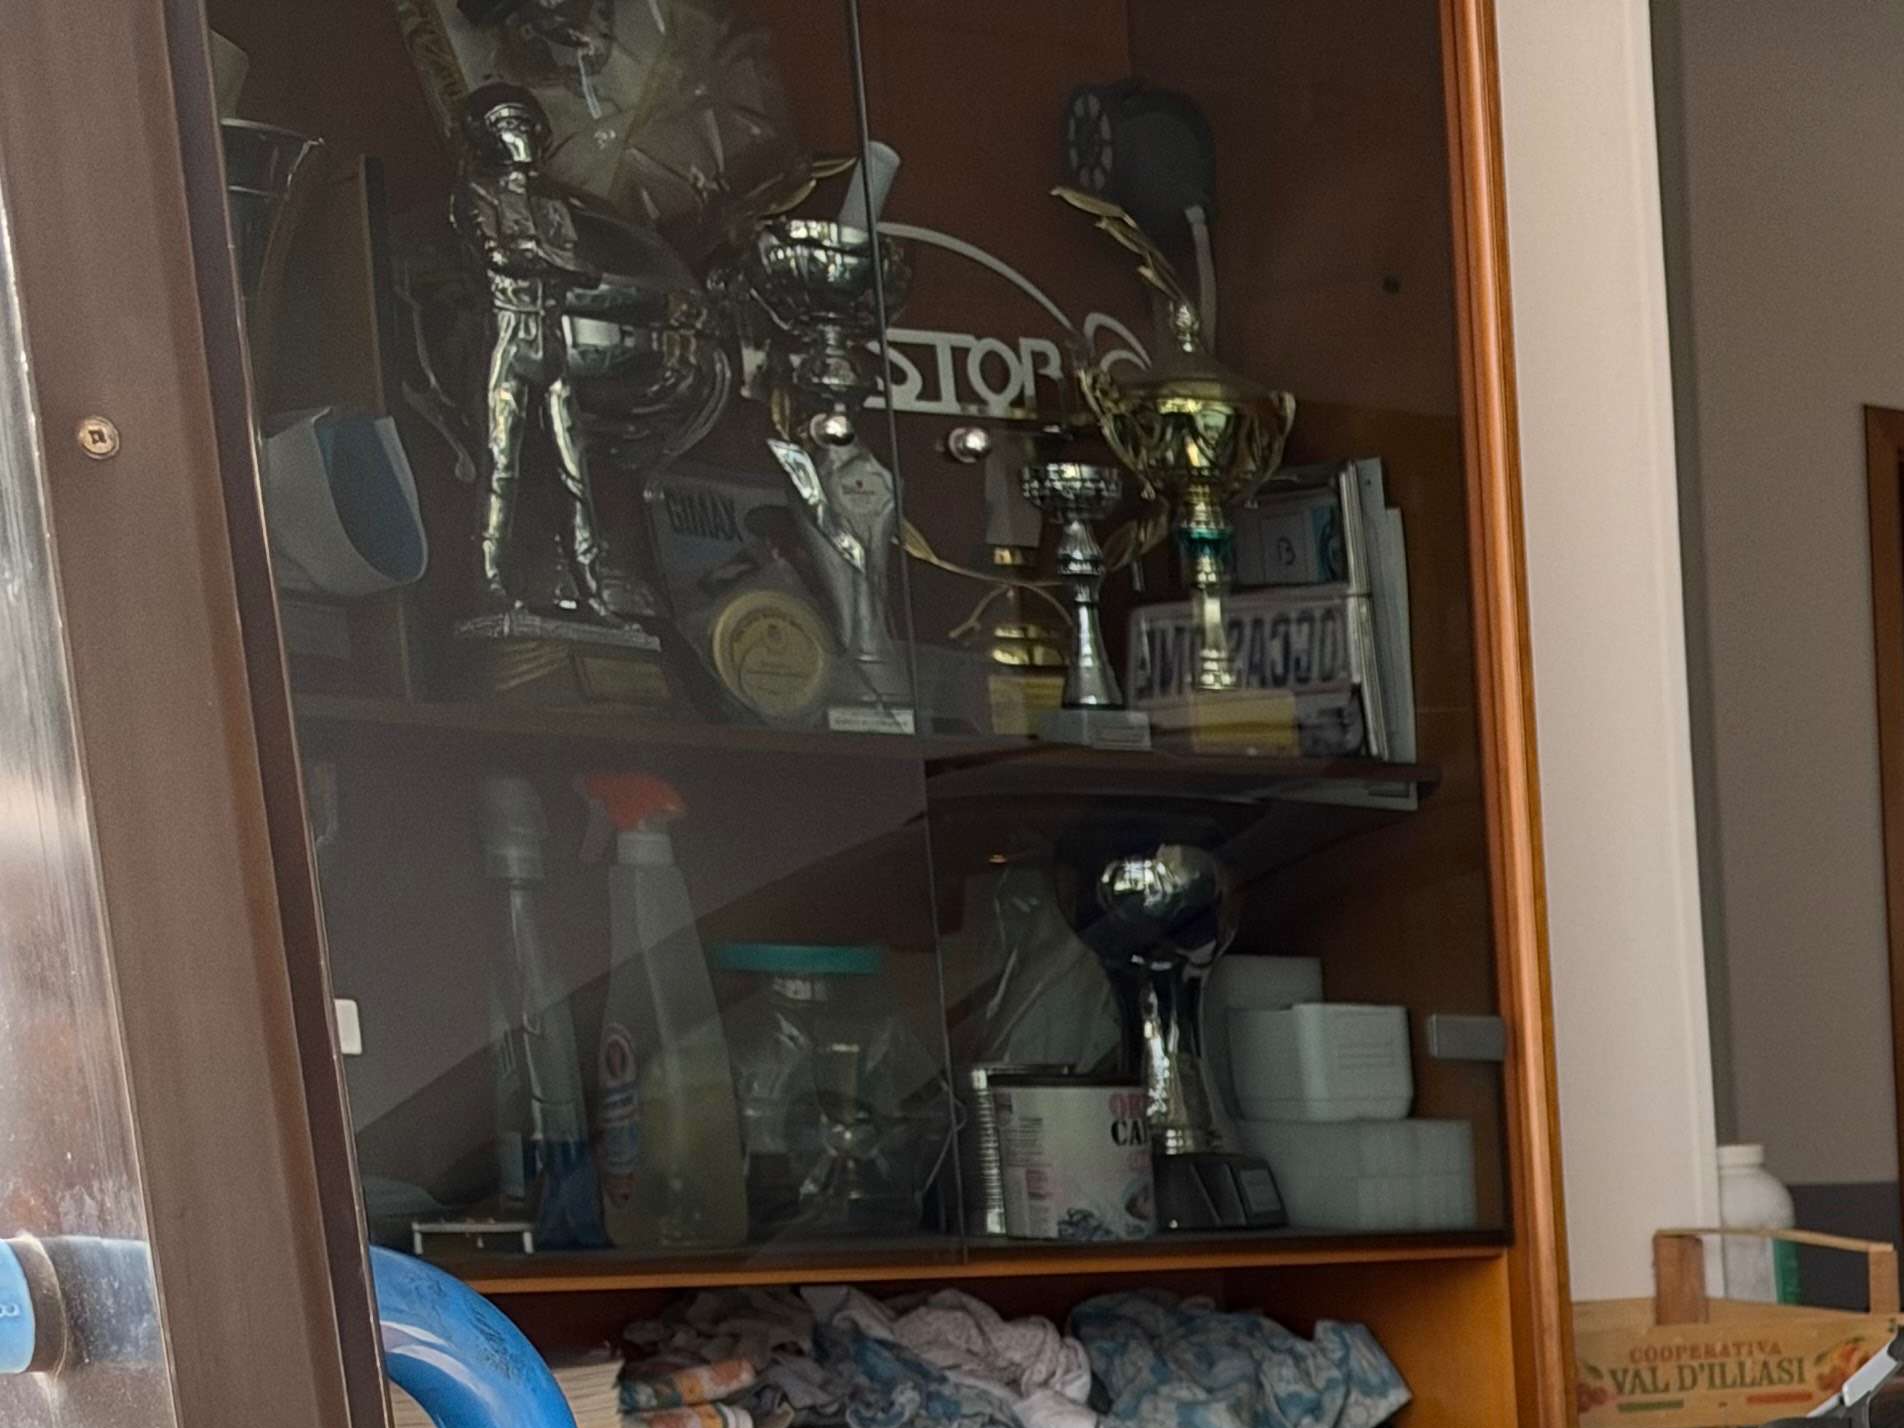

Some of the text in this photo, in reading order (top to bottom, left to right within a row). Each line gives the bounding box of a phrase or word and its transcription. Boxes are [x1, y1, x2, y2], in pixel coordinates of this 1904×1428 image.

[1111, 1119, 1148, 1146] CA
[1629, 1341, 1783, 1364] COOPERATIVA
[1609, 1357, 1807, 1396] VAL D'ILLASI
